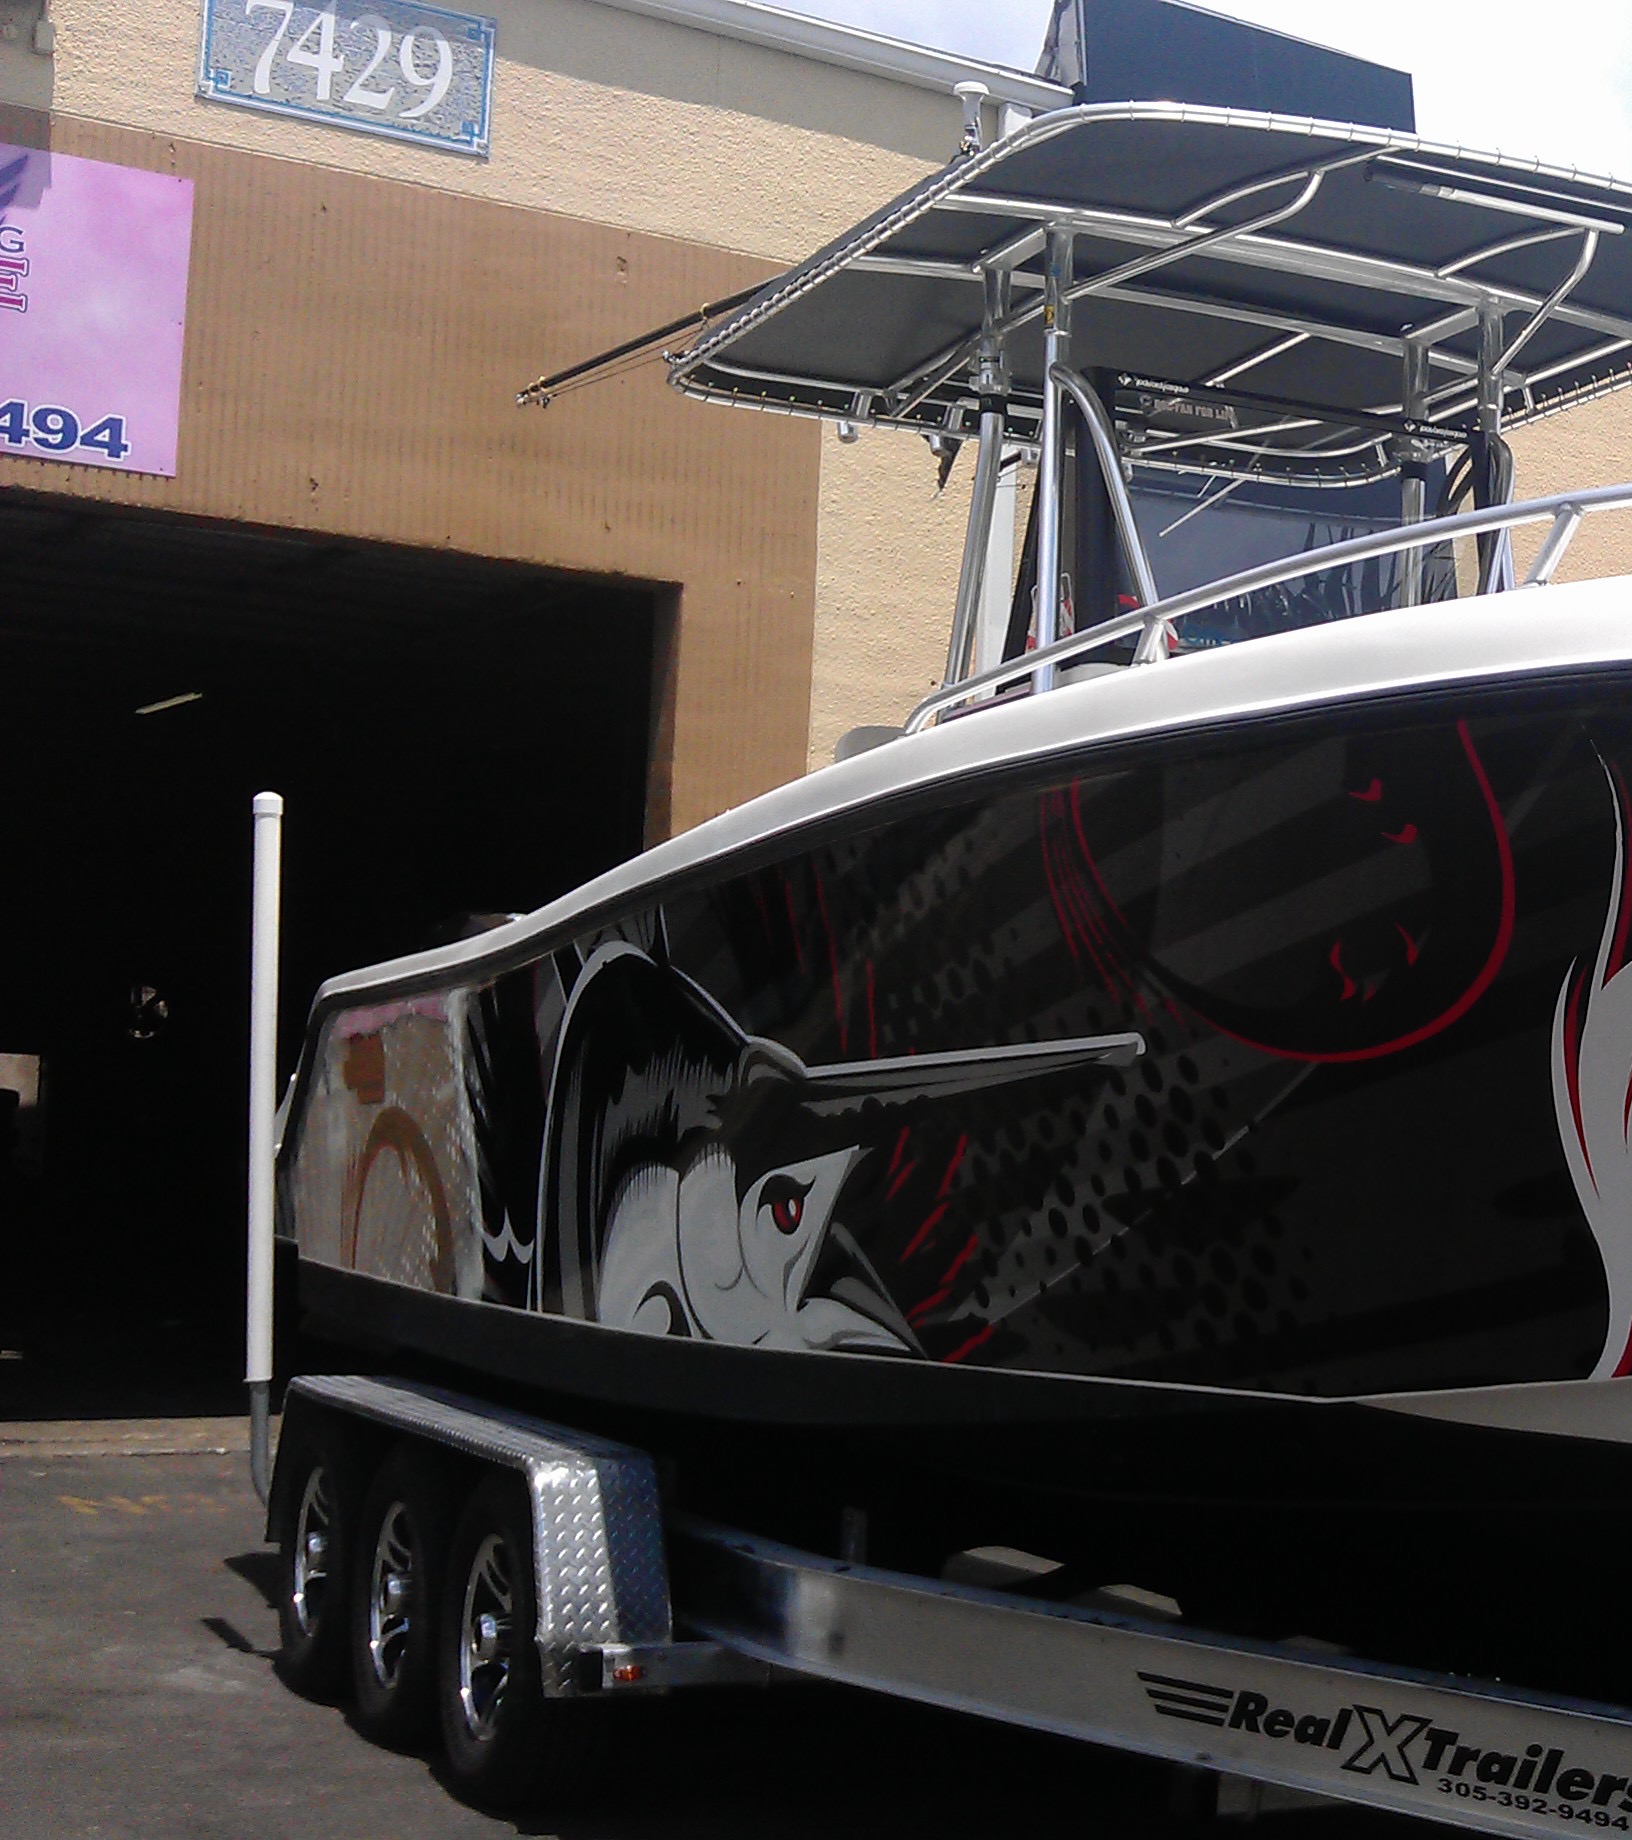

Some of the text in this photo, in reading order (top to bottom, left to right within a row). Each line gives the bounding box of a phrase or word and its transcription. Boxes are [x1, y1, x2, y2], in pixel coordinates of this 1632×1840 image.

[244, 0, 452, 118] 7429
[0, 399, 131, 462] 494
[1437, 1777, 1630, 1832] 305-392-9494
